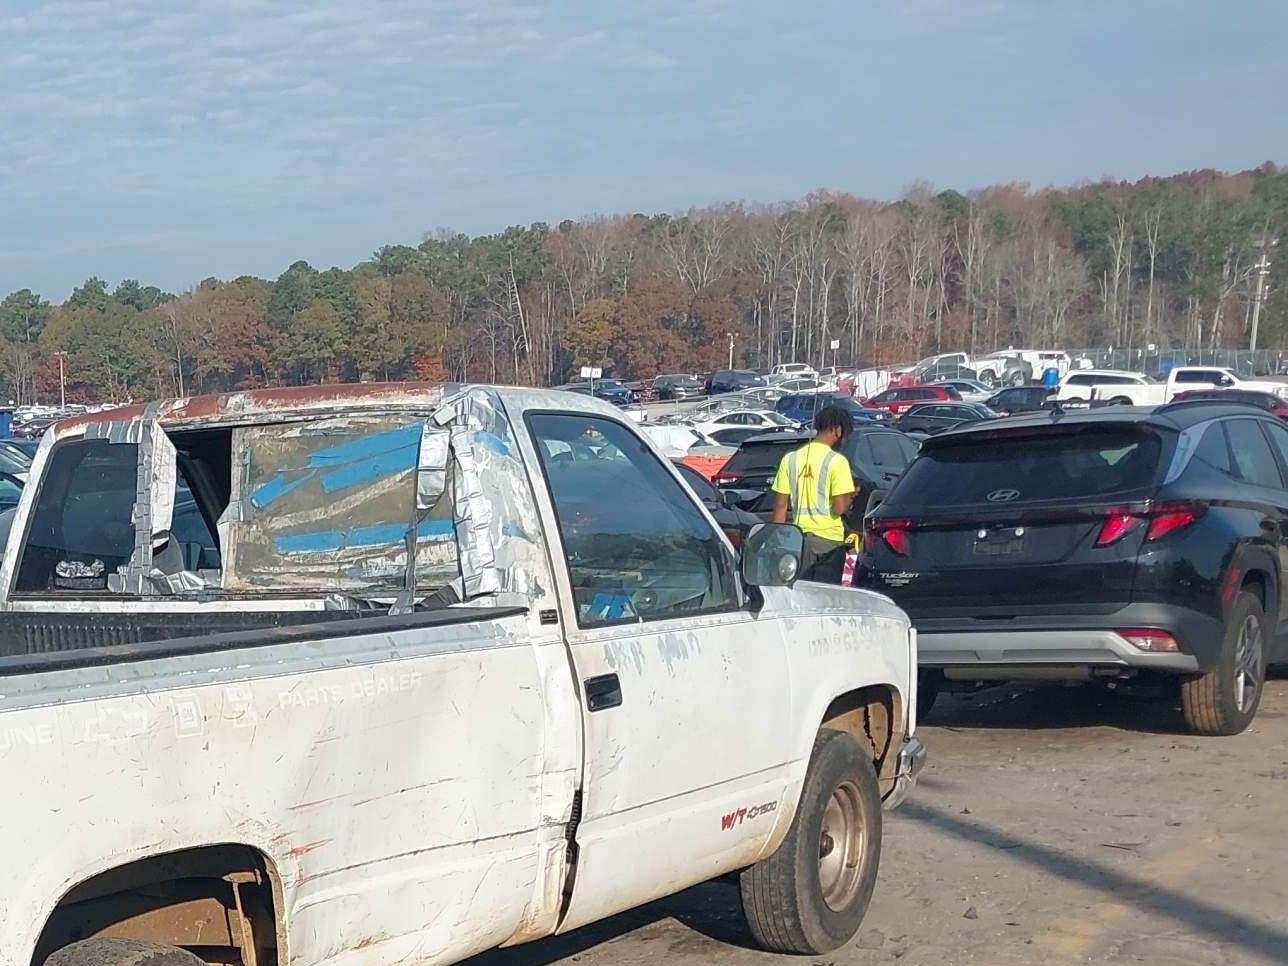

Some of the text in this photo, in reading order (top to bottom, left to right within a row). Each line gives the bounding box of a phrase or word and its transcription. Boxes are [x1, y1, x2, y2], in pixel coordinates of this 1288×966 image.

[278, 684, 345, 710] PARTS
[352, 672, 424, 698] DEALER
[721, 807, 747, 831] W/T
